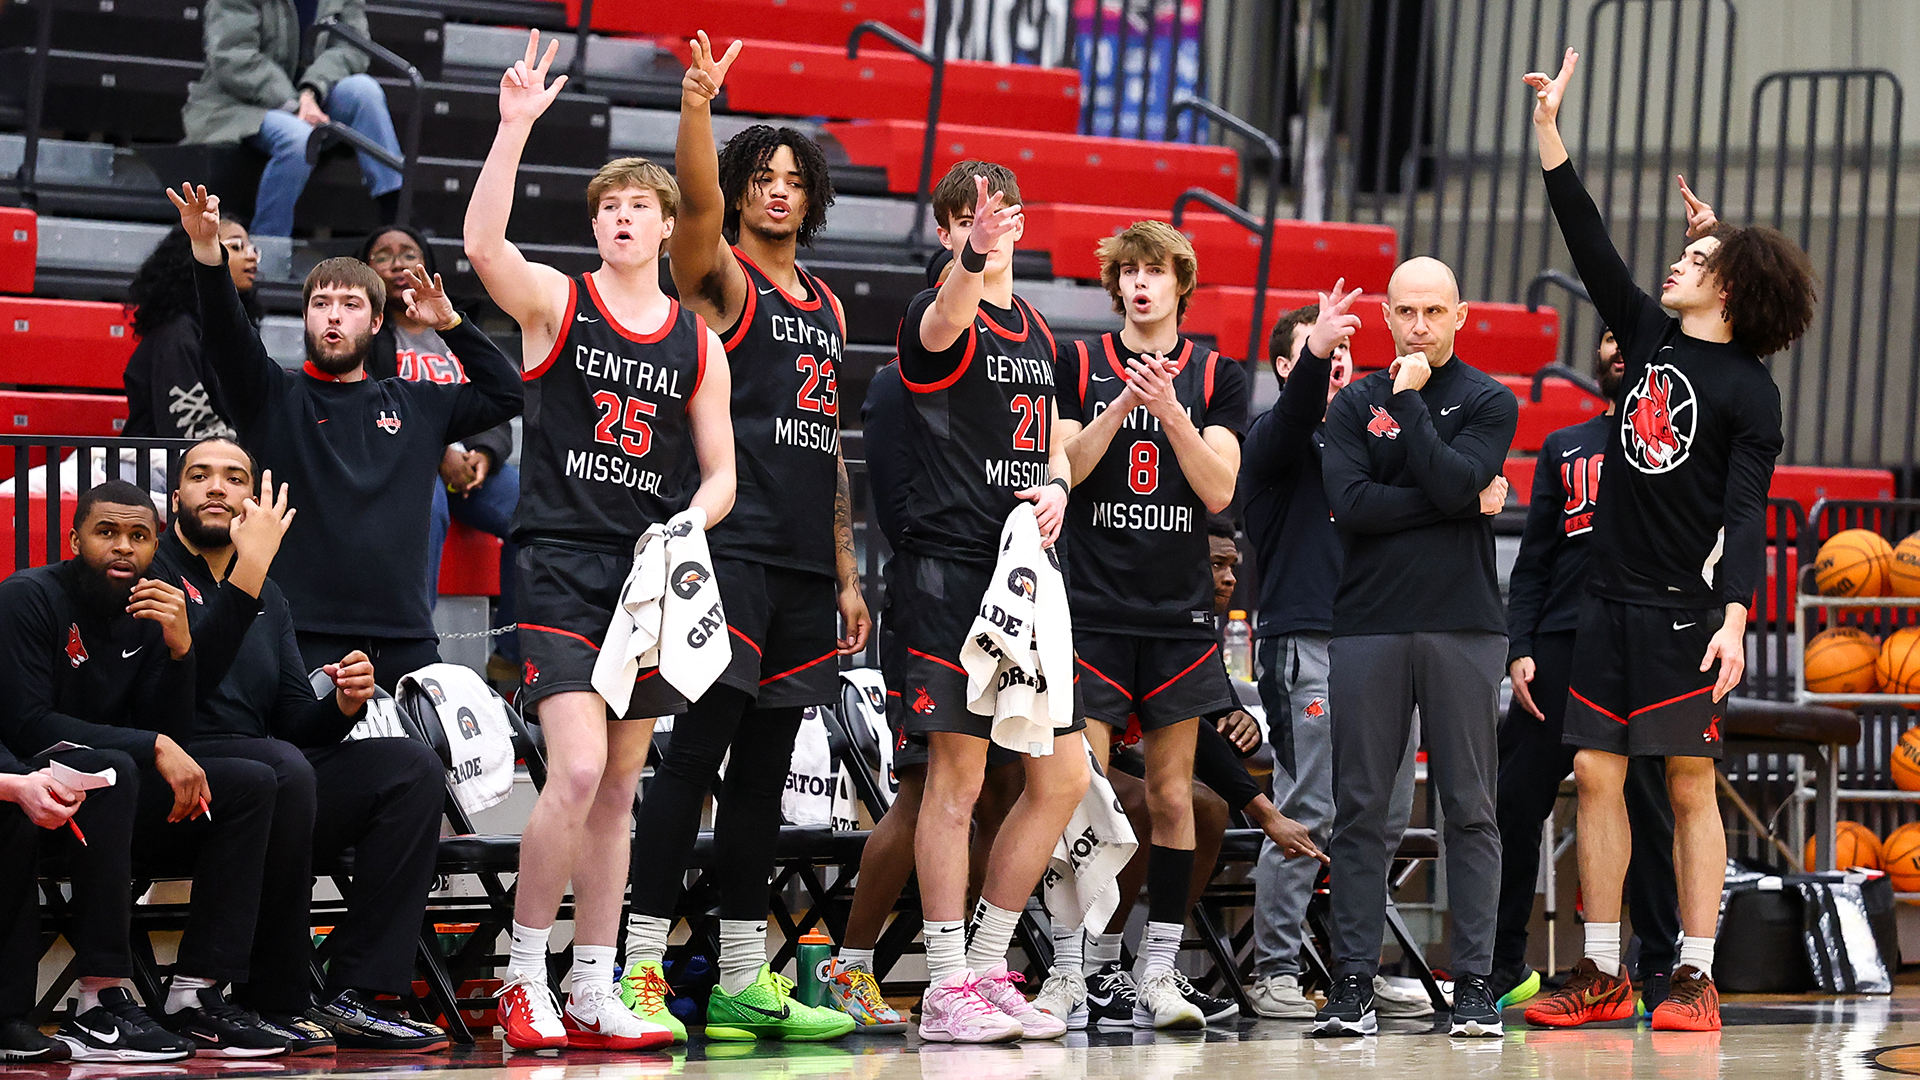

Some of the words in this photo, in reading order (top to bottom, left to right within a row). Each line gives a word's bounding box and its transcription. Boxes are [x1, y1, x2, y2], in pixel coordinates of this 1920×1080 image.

[575, 344, 682, 399] CENTRAL
[796, 353, 838, 417] 23
[986, 354, 1055, 387] CENTRAL
[592, 389, 658, 458] 25
[1010, 394, 1046, 453] 21
[1127, 440, 1160, 496] 8
[1092, 501, 1193, 533] MISSOURI
